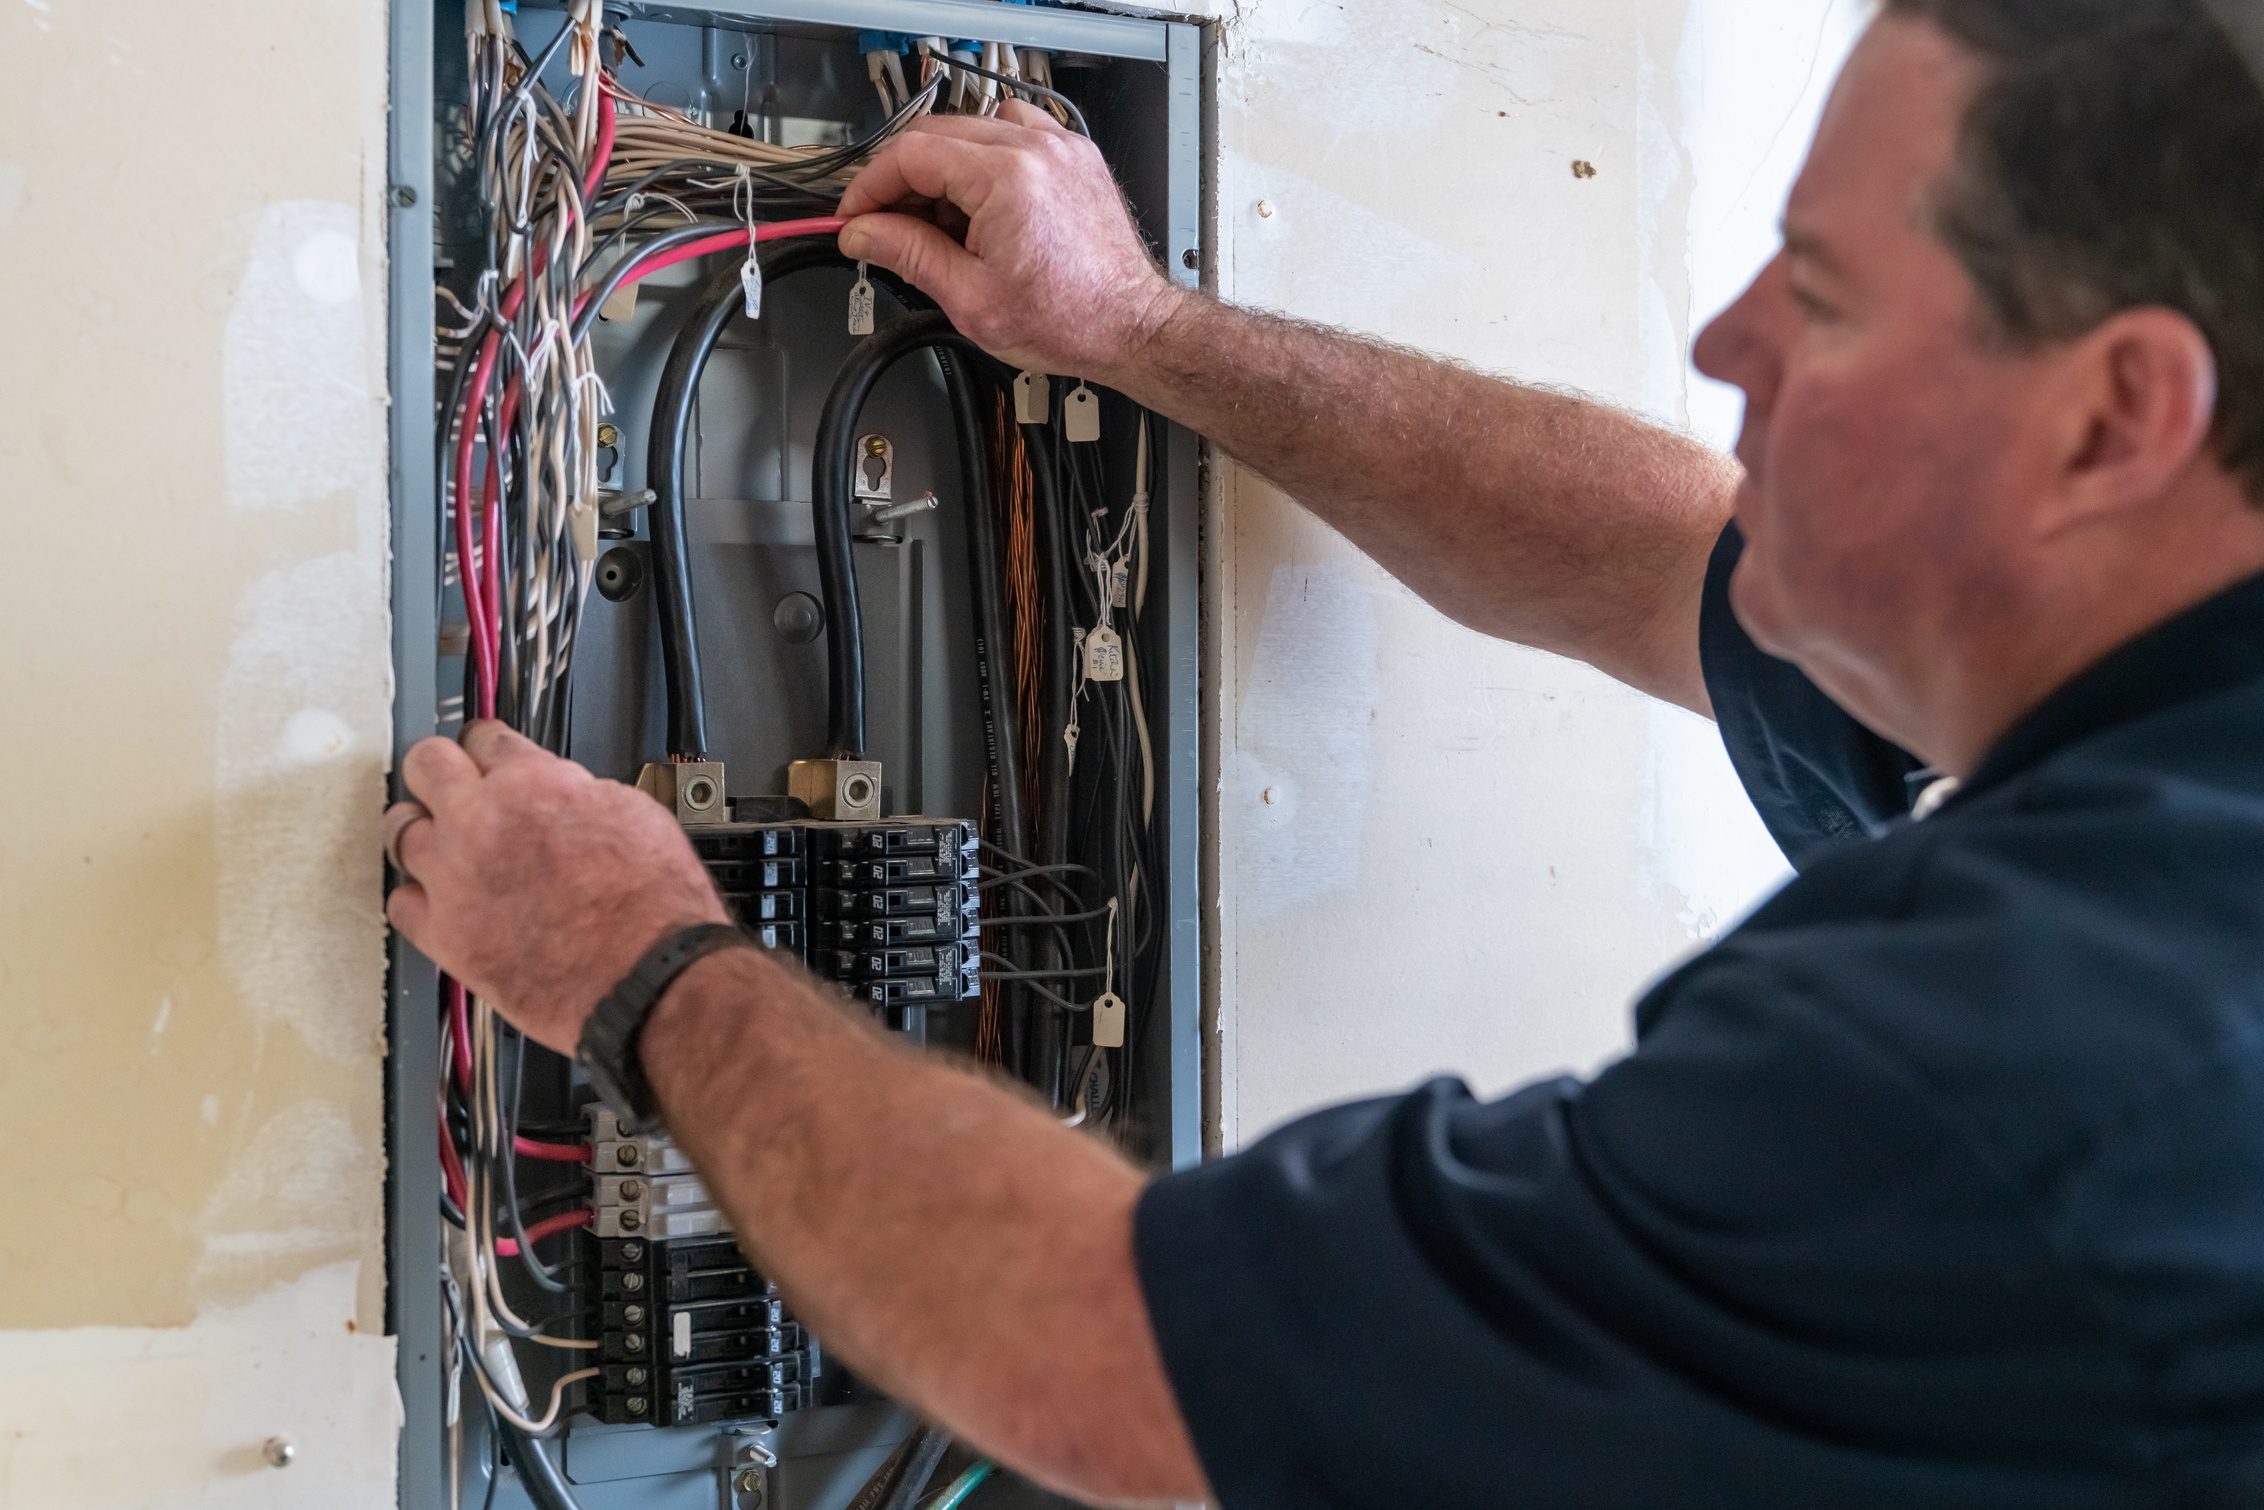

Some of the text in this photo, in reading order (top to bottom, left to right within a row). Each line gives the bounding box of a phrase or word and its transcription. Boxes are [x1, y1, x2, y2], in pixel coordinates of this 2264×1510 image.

[979, 661, 987, 677] 600V
[986, 720, 996, 759] RESISTANT
[872, 834, 883, 849] 20
[872, 865, 884, 880] 20
[872, 895, 884, 910] 20
[873, 926, 884, 941] 20
[871, 957, 882, 971] 20
[872, 986, 883, 1000] 20
[770, 1308, 779, 1322] 20
[770, 1338, 779, 1352] 20
[773, 1370, 782, 1384] 20
[774, 1400, 782, 1414] 20
